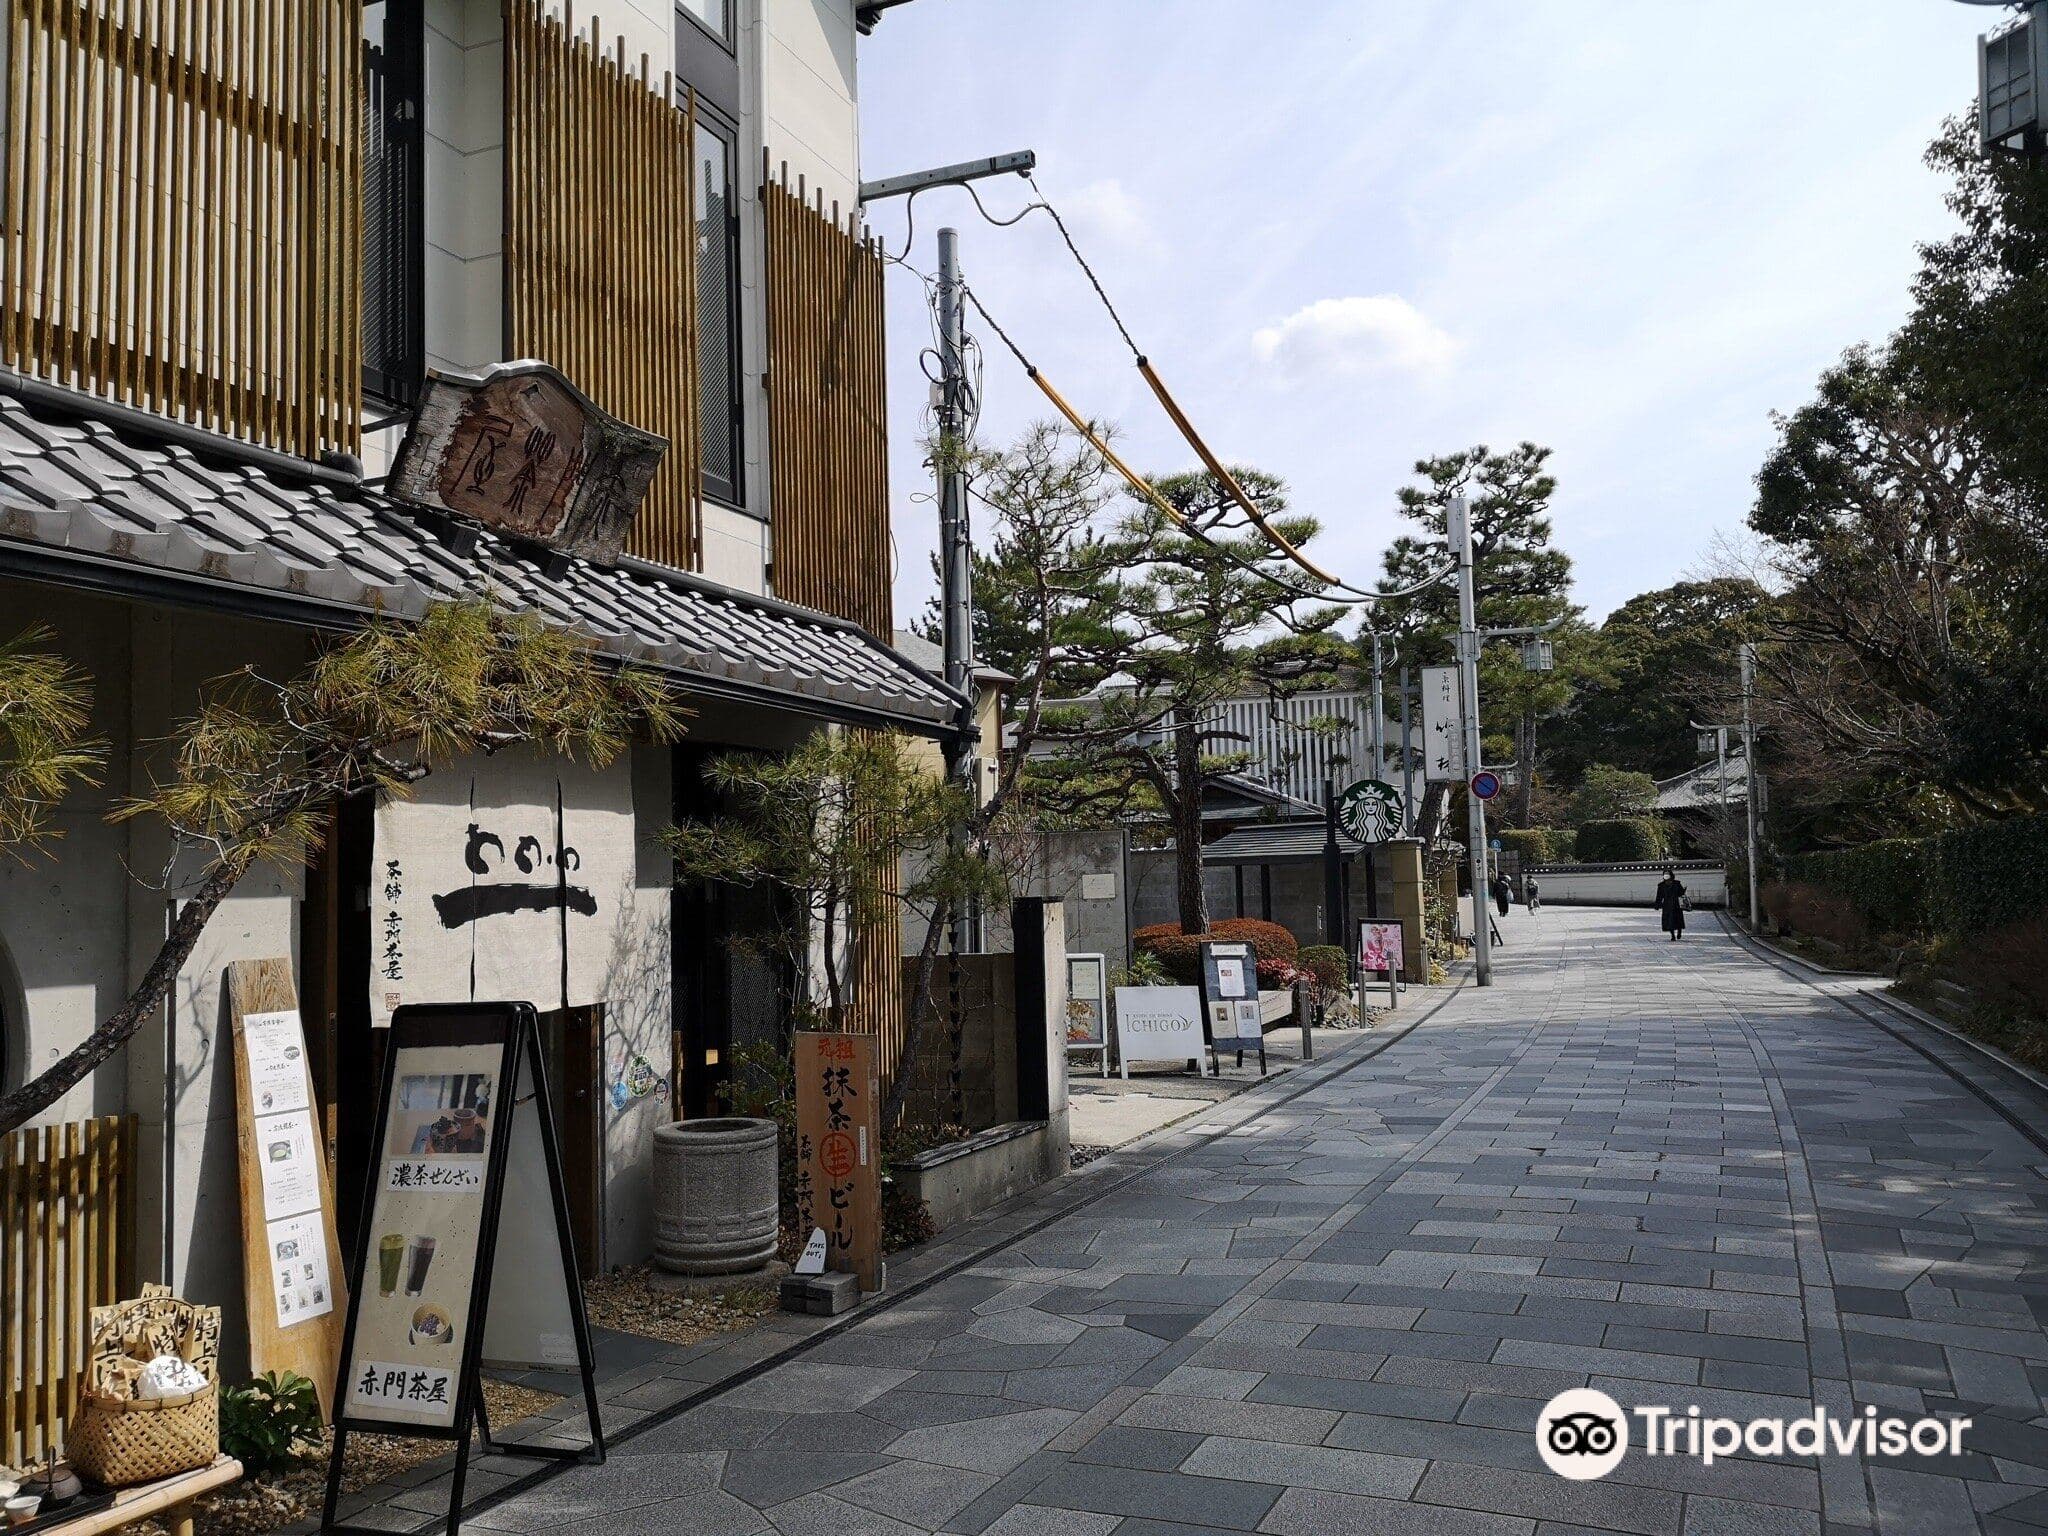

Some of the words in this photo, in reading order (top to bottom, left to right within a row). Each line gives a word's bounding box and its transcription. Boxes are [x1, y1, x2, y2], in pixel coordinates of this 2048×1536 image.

[381, 910, 404, 981] 赤門茶屋
[1125, 1013, 1181, 1033] ICHIGO
[392, 1166, 479, 1189] 濃茶ぜんざい
[357, 1364, 449, 1405] 赤門茶屋
